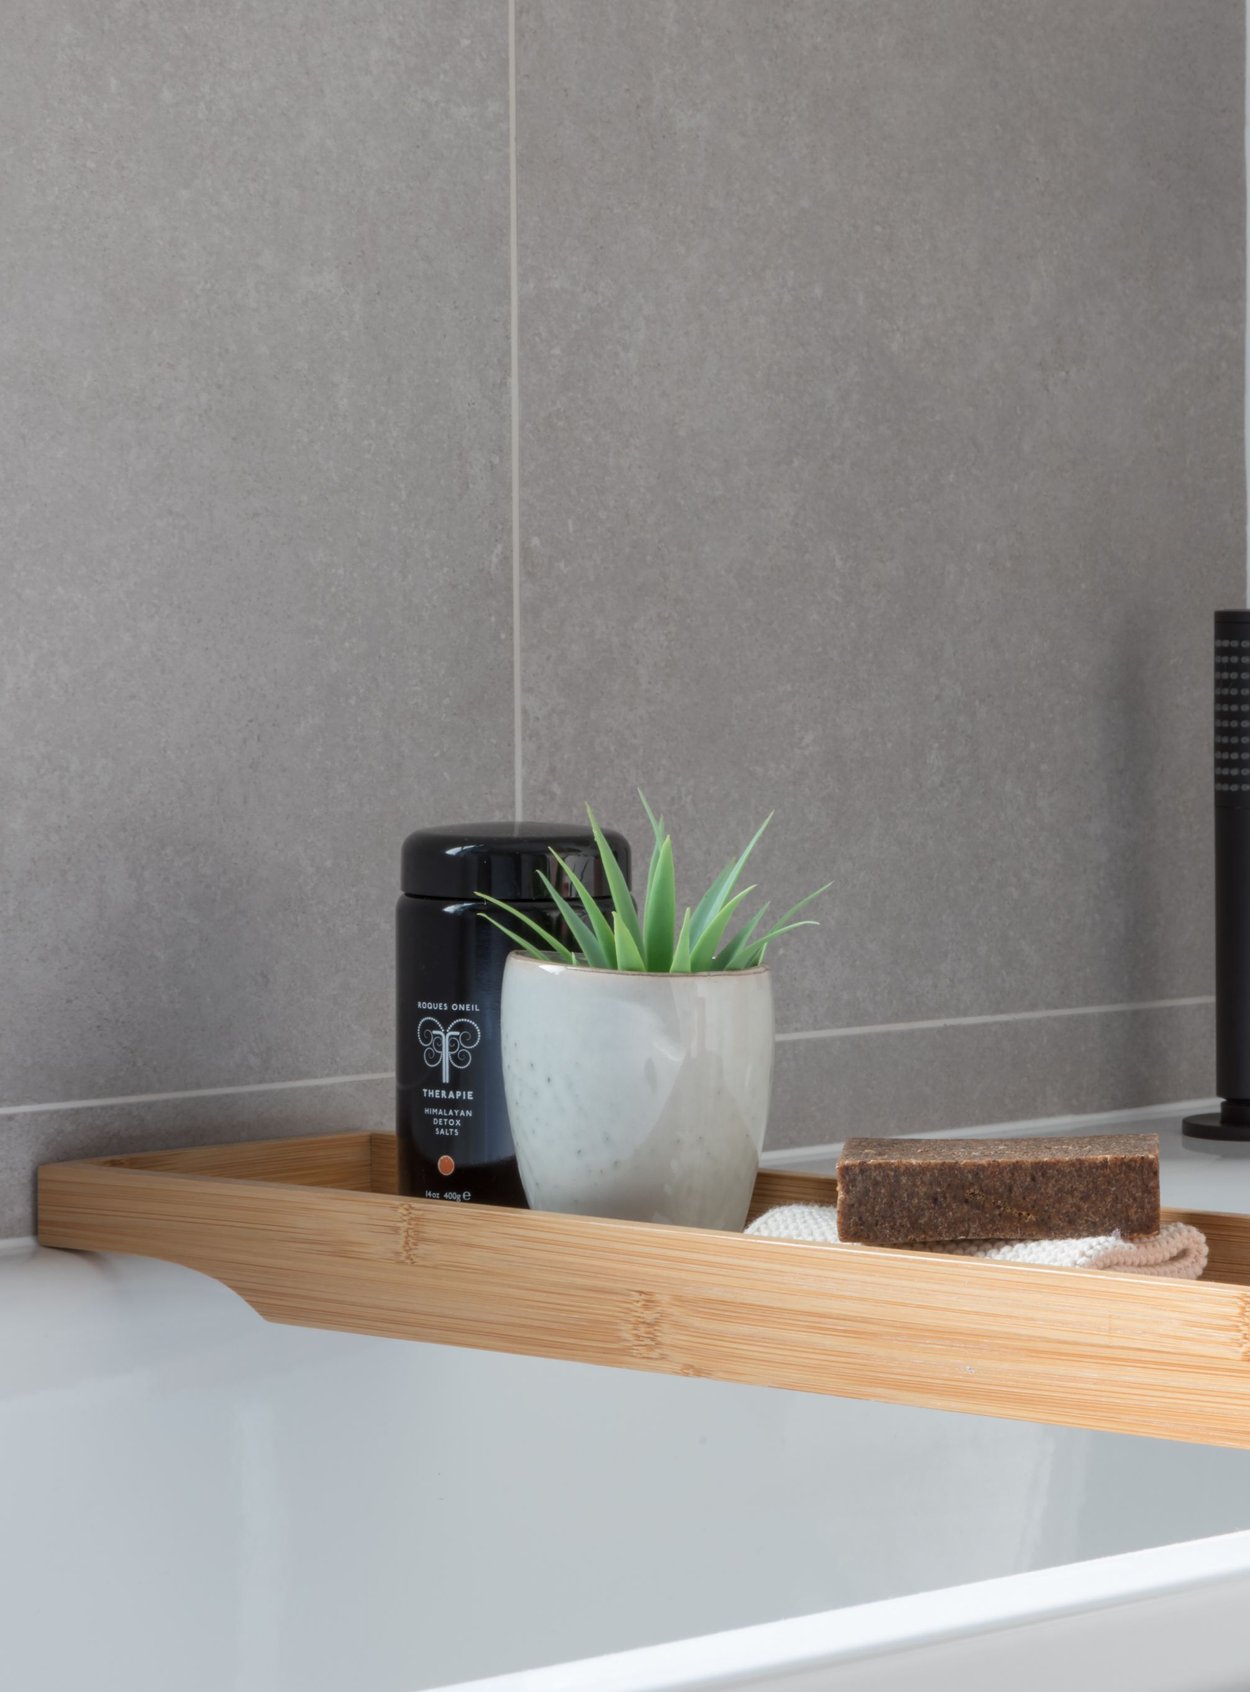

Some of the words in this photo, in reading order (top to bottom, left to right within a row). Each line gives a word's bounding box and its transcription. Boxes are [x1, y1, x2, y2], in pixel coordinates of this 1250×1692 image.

[417, 1001, 448, 1011] ROQUES
[451, 1003, 480, 1012] ONEIL
[422, 1088, 474, 1100] THERAPIE
[424, 1107, 473, 1117] HIMALAYAN
[433, 1117, 461, 1127] DETOX
[435, 1128, 459, 1136] SALTS
